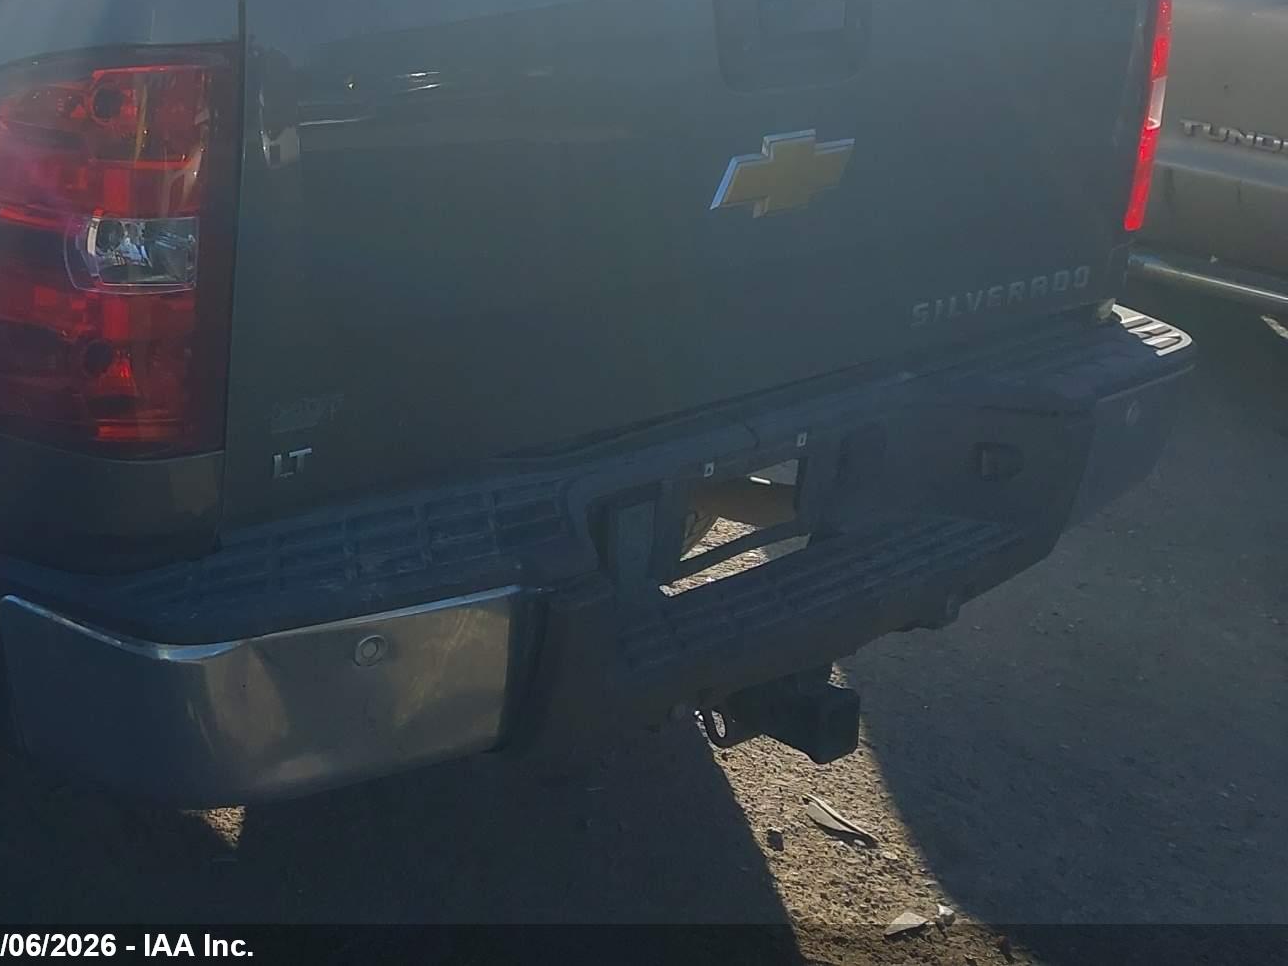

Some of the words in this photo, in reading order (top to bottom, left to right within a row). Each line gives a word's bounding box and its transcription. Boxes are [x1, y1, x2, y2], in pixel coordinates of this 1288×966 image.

[1178, 118, 1288, 155] TUND
[909, 265, 1091, 330] SILVERADO
[272, 446, 313, 480] LT
